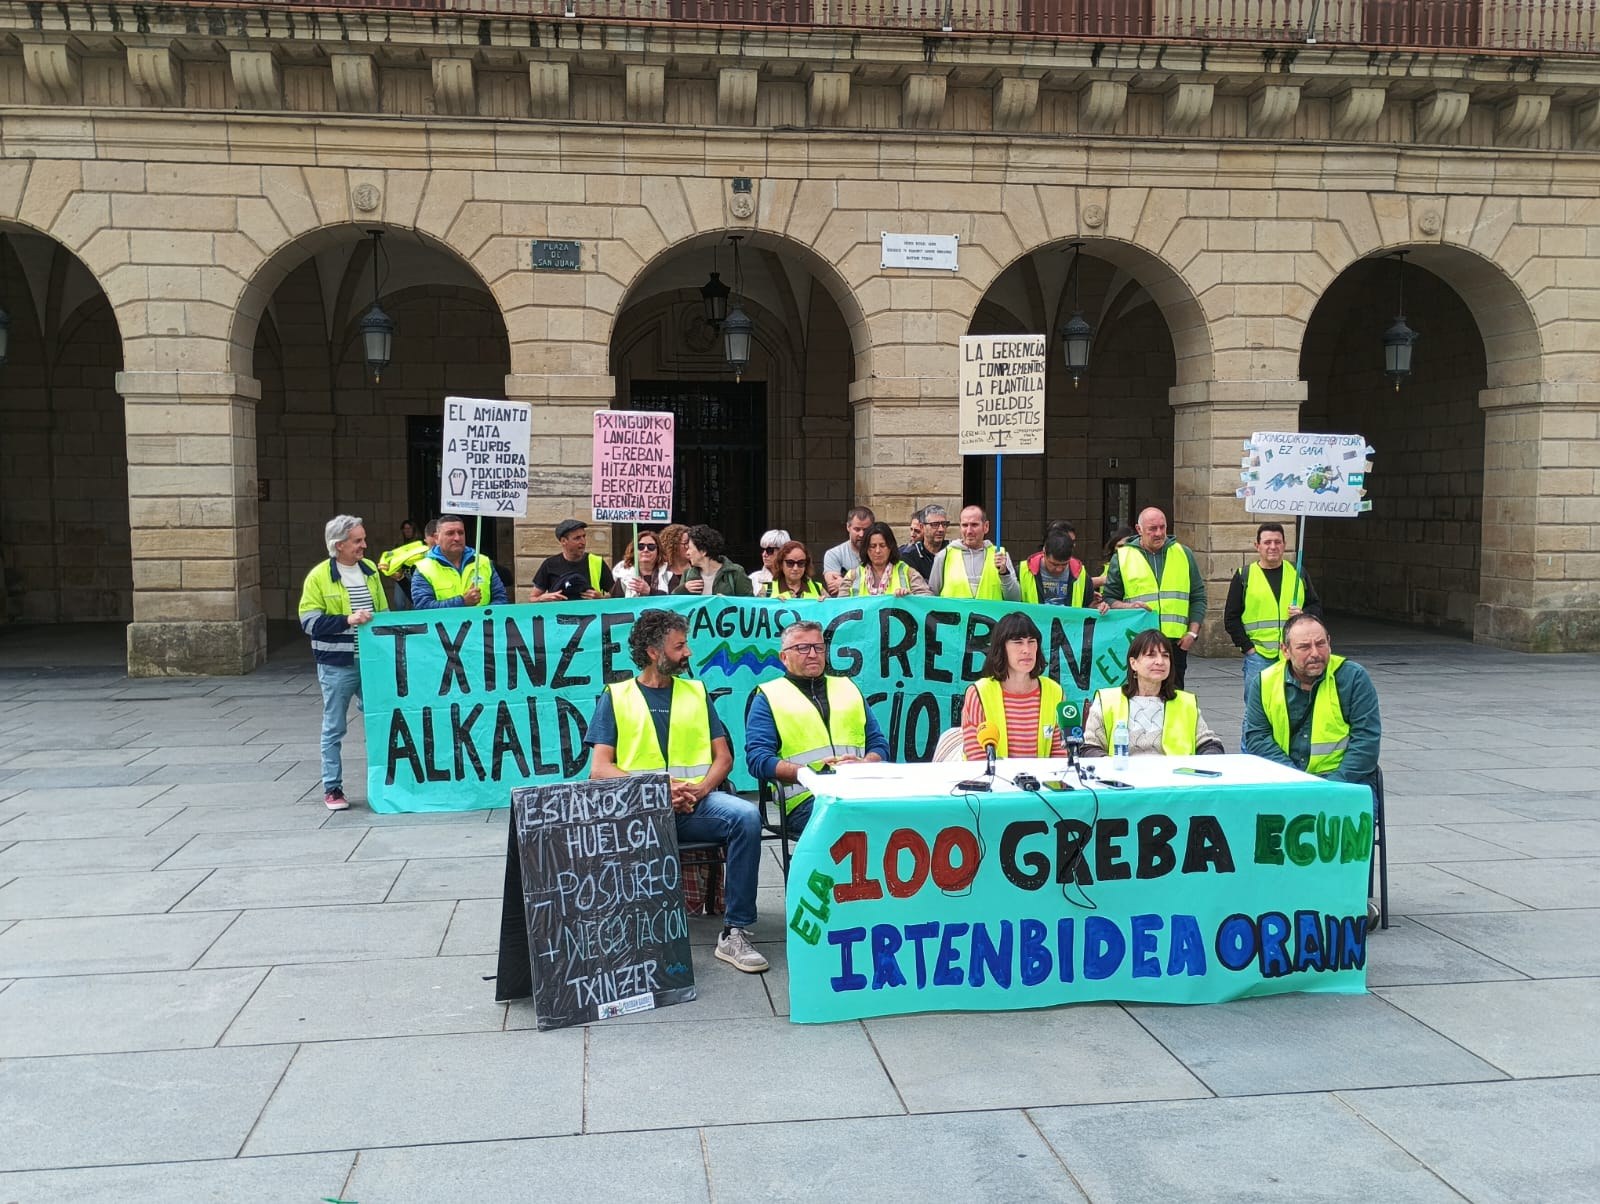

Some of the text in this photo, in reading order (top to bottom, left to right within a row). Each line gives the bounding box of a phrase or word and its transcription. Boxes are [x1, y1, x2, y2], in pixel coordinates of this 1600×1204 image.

[543, 243, 569, 251] PLAZA
[551, 250, 561, 259] DE
[538, 258, 575, 267] SAN JUAN
[965, 339, 1045, 362] LA GERENCIA
[966, 376, 1043, 397] LA PLANTILLA
[449, 404, 528, 422] EL AMIANTO
[976, 396, 1034, 413] SUELDOS
[595, 413, 672, 430] TXINGUDIKO
[977, 411, 1040, 427] MODESTOS
[466, 425, 500, 438] MATA
[603, 429, 663, 445] LANGILEAK
[447, 438, 511, 453] A 3 EUROS
[1279, 445, 1293, 455] EZ
[466, 452, 526, 466] POR HORA
[470, 467, 527, 480] TOXICIDAD
[601, 461, 672, 478] HITZARMENA
[470, 489, 520, 500] PENOSIDAD
[601, 478, 672, 495] BERRITZEKO
[496, 499, 515, 511] YA
[593, 493, 671, 510] GERENTZIA ESERI
[1250, 499, 1350, 513] VICIOS DE TXINGUDI
[371, 609, 694, 697] TXINZE
[824, 607, 1097, 690] GREBN
[385, 695, 600, 785] ALKALD
[523, 783, 668, 826] ESTAMOS EN
[566, 816, 660, 858] HUELGA
[829, 826, 982, 904] 100
[1000, 814, 1235, 891] GREBA
[557, 855, 678, 916] POSTUREO
[789, 869, 835, 946] ELA
[827, 910, 1368, 993] IRTENBIDEA ORAIN
[566, 959, 661, 1009] TXINZER
